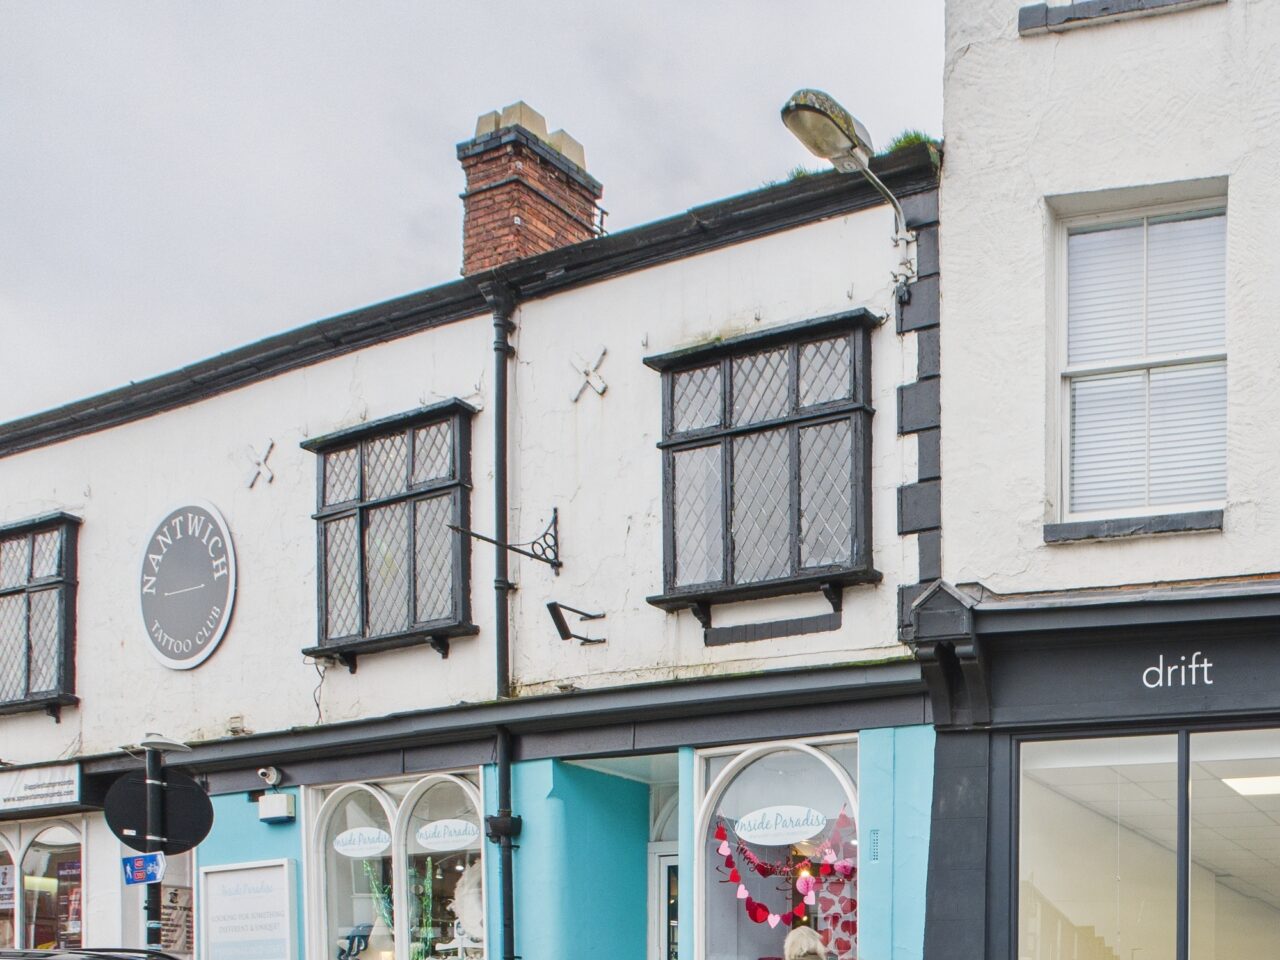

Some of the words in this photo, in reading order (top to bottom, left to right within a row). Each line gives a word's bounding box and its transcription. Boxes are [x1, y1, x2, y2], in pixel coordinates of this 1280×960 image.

[143, 513, 228, 595] NANTWICH
[151, 620, 193, 653] TATTOO
[195, 606, 221, 645] CLUB
[1142, 651, 1213, 688] drift
